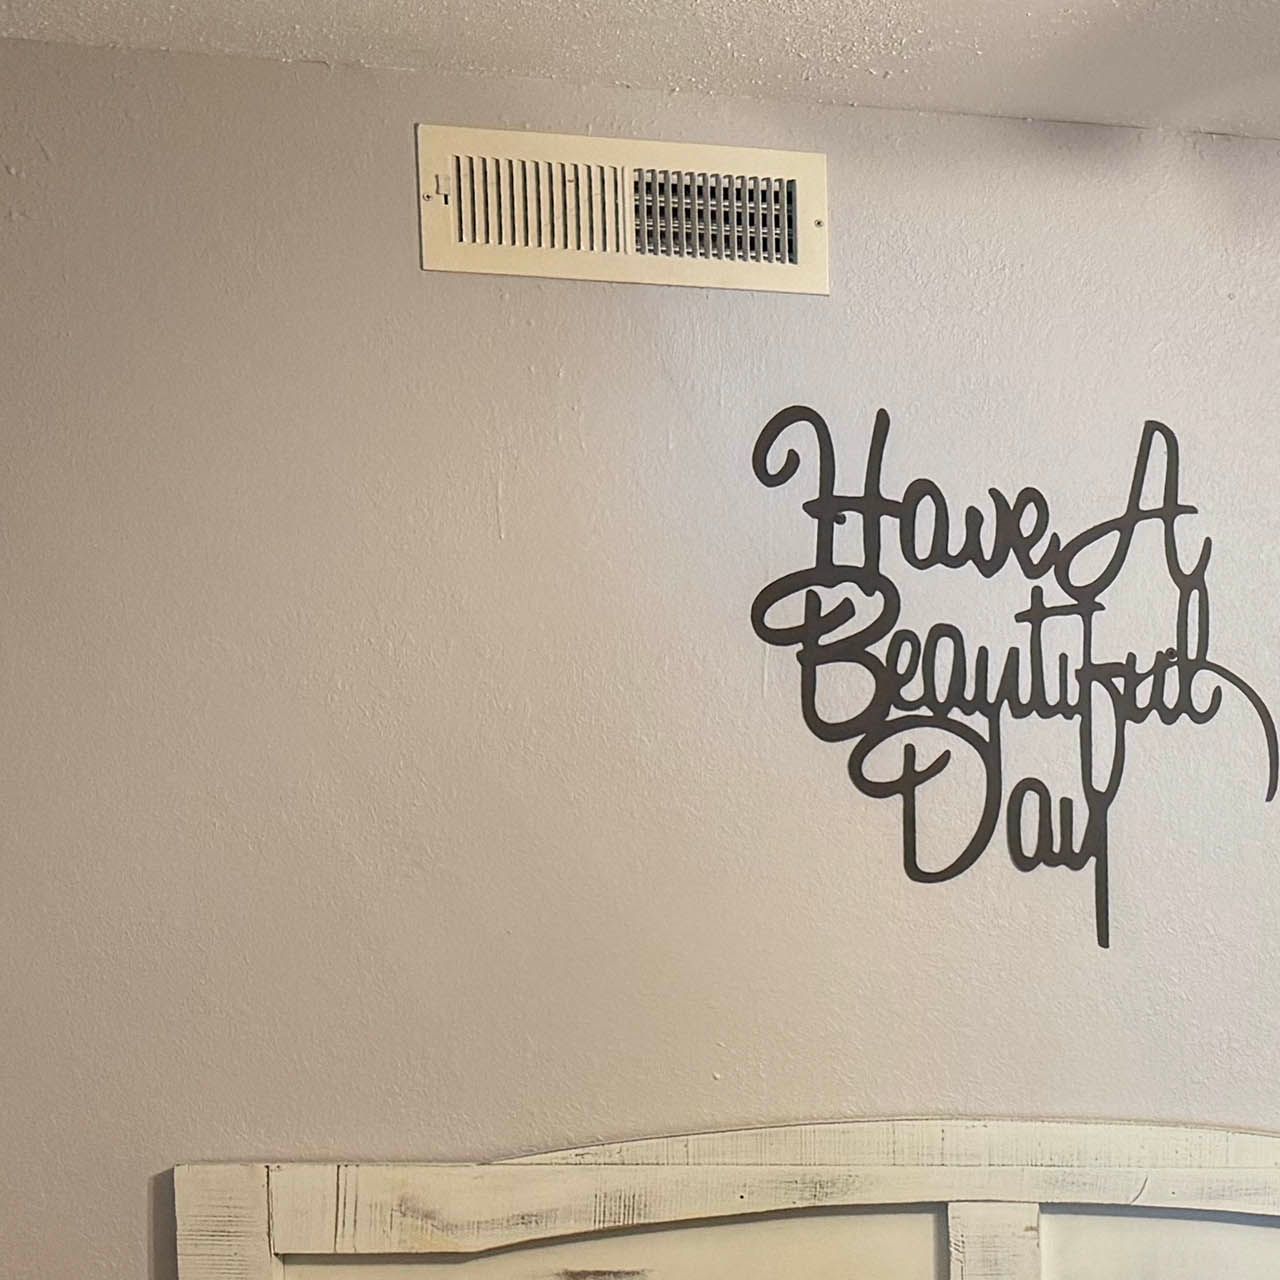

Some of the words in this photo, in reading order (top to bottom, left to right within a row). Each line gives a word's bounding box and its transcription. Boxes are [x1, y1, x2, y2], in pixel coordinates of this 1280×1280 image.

[752, 405, 1060, 592] Have
[1053, 420, 1212, 602] A
[751, 565, 1279, 802] Beautiful
[848, 714, 1110, 949] Day
